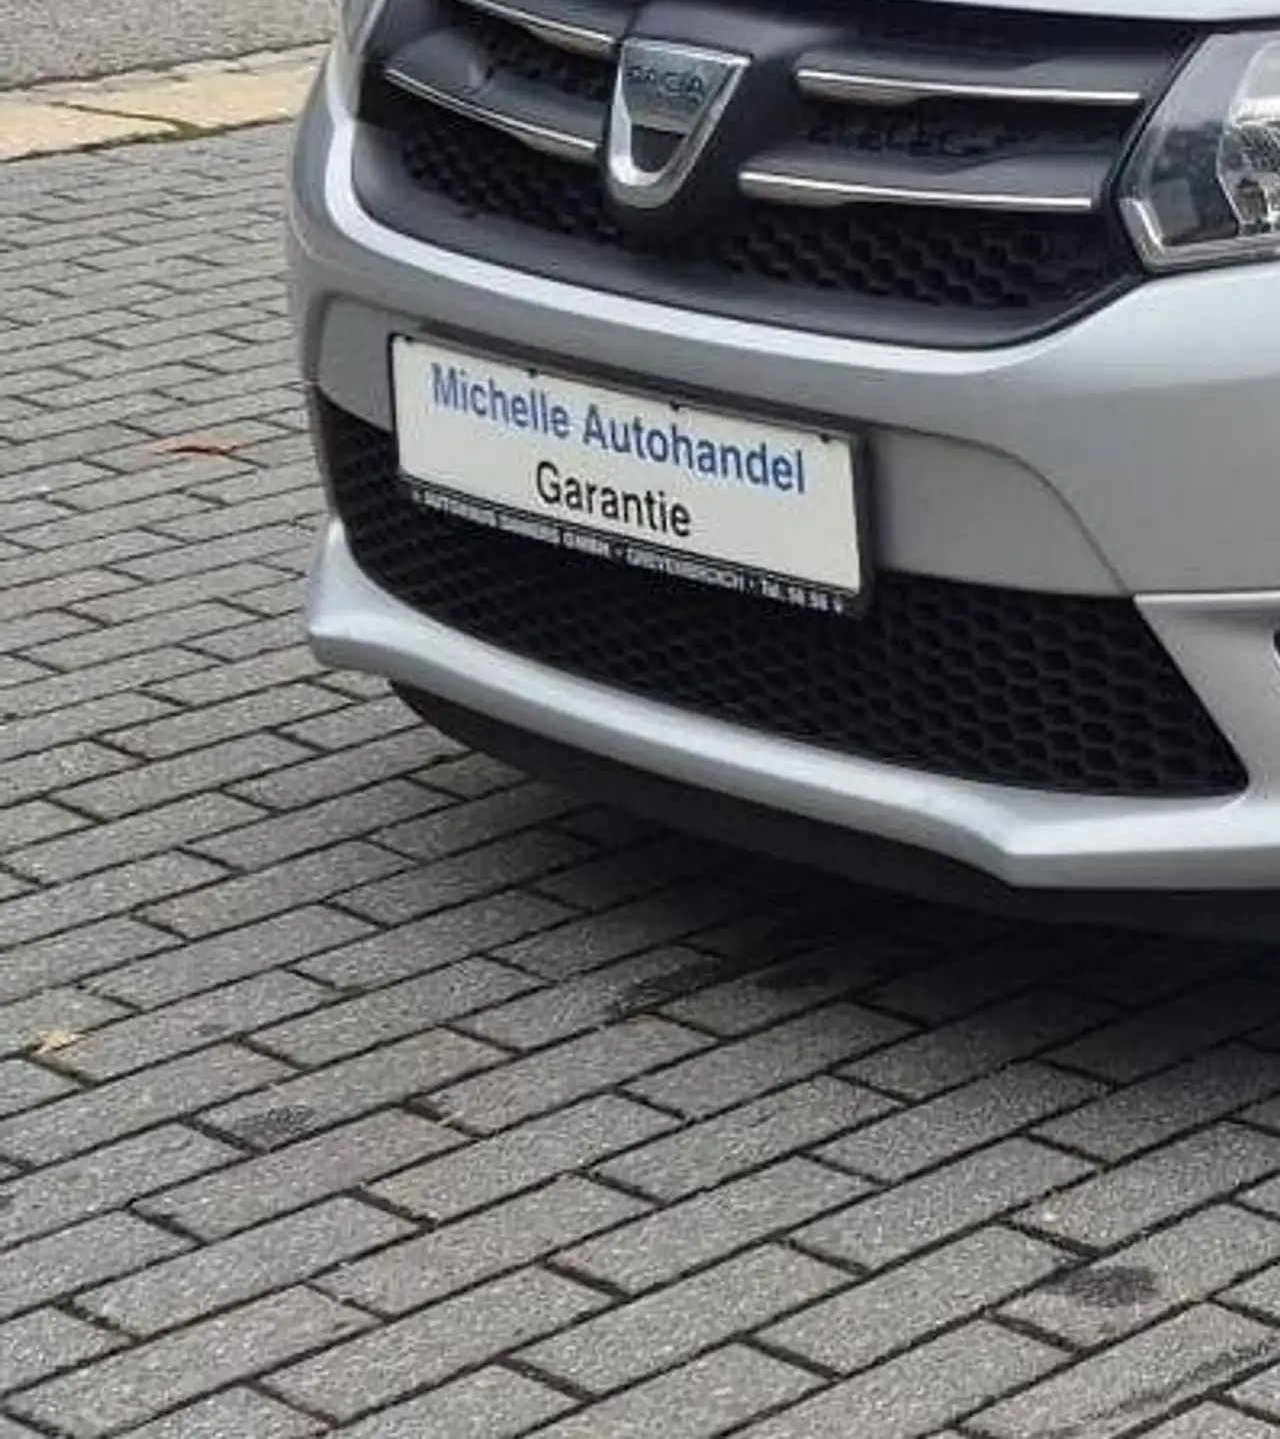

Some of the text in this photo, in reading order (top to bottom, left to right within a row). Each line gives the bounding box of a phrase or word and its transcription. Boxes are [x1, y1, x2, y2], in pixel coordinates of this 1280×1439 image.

[431, 362, 806, 494] Michelle Autohandel
[535, 460, 692, 537] Garantie
